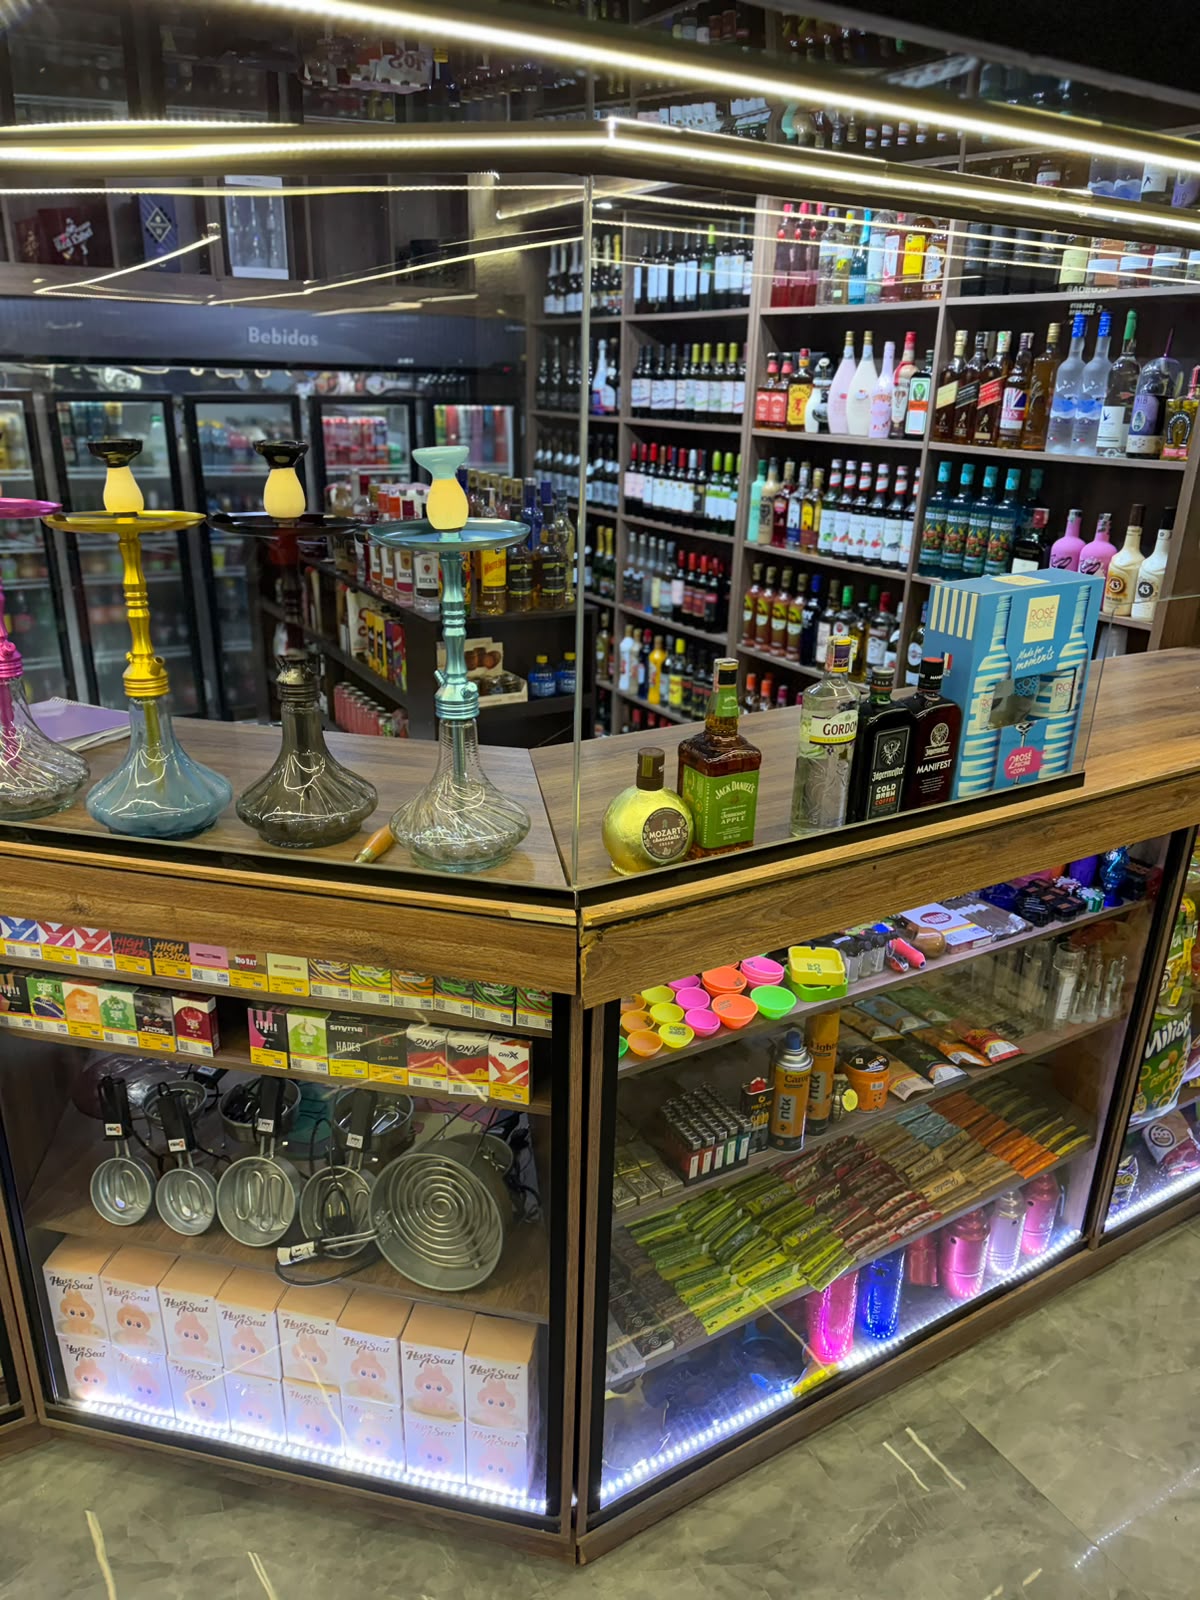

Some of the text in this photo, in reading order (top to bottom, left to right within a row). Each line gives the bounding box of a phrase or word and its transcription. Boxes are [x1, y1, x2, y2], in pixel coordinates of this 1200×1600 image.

[248, 326, 319, 346] Bebidas
[1030, 604, 1055, 620] ROSÉ
[1014, 646, 1055, 672] moments
[916, 759, 952, 774] MANIFEST
[715, 784, 731, 800] JACK
[875, 791, 896, 800] BREW
[876, 783, 897, 793] COLD
[874, 797, 896, 806] COFFEE
[720, 815, 746, 825] APPLE
[649, 827, 682, 839] MOZART
[114, 937, 145, 949] HIGH
[154, 942, 184, 952] HIGH
[152, 951, 191, 962] PASSION
[336, 1041, 361, 1052] HADES
[49, 1275, 73, 1287] Have
[72, 1279, 94, 1291] Seat
[164, 1297, 188, 1310] Have
[187, 1301, 209, 1313] Seat
[221, 1310, 246, 1322] Have
[244, 1316, 267, 1328] Seat
[283, 1318, 309, 1331] Have
[307, 1324, 330, 1336] Seat
[342, 1336, 368, 1348] Have
[366, 1342, 390, 1354] Seat
[405, 1349, 433, 1361] Have
[430, 1354, 456, 1366] Seat
[469, 1364, 497, 1376] Have
[495, 1369, 520, 1381] Seat
